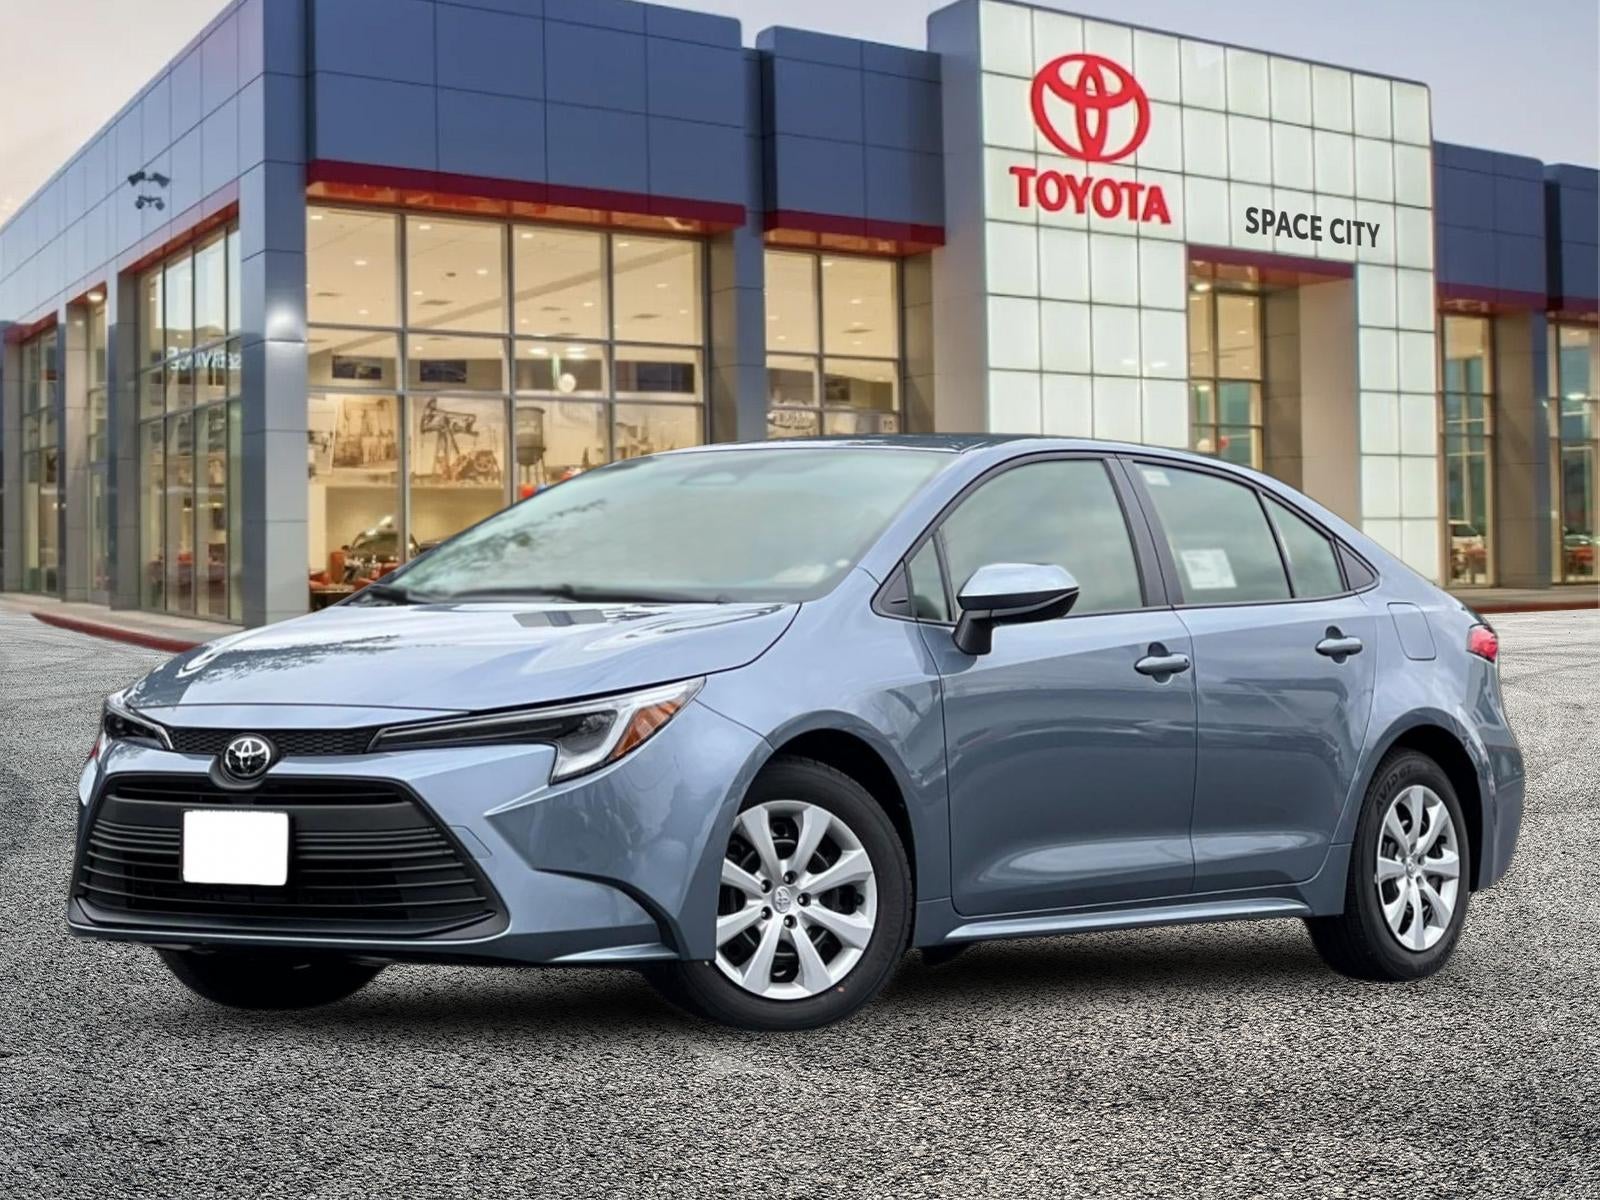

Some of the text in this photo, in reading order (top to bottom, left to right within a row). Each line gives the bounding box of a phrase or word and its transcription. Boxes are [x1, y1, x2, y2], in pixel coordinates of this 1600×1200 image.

[1009, 166, 1171, 224] TOYOTA
[1245, 206, 1381, 248] SPACE CITY
